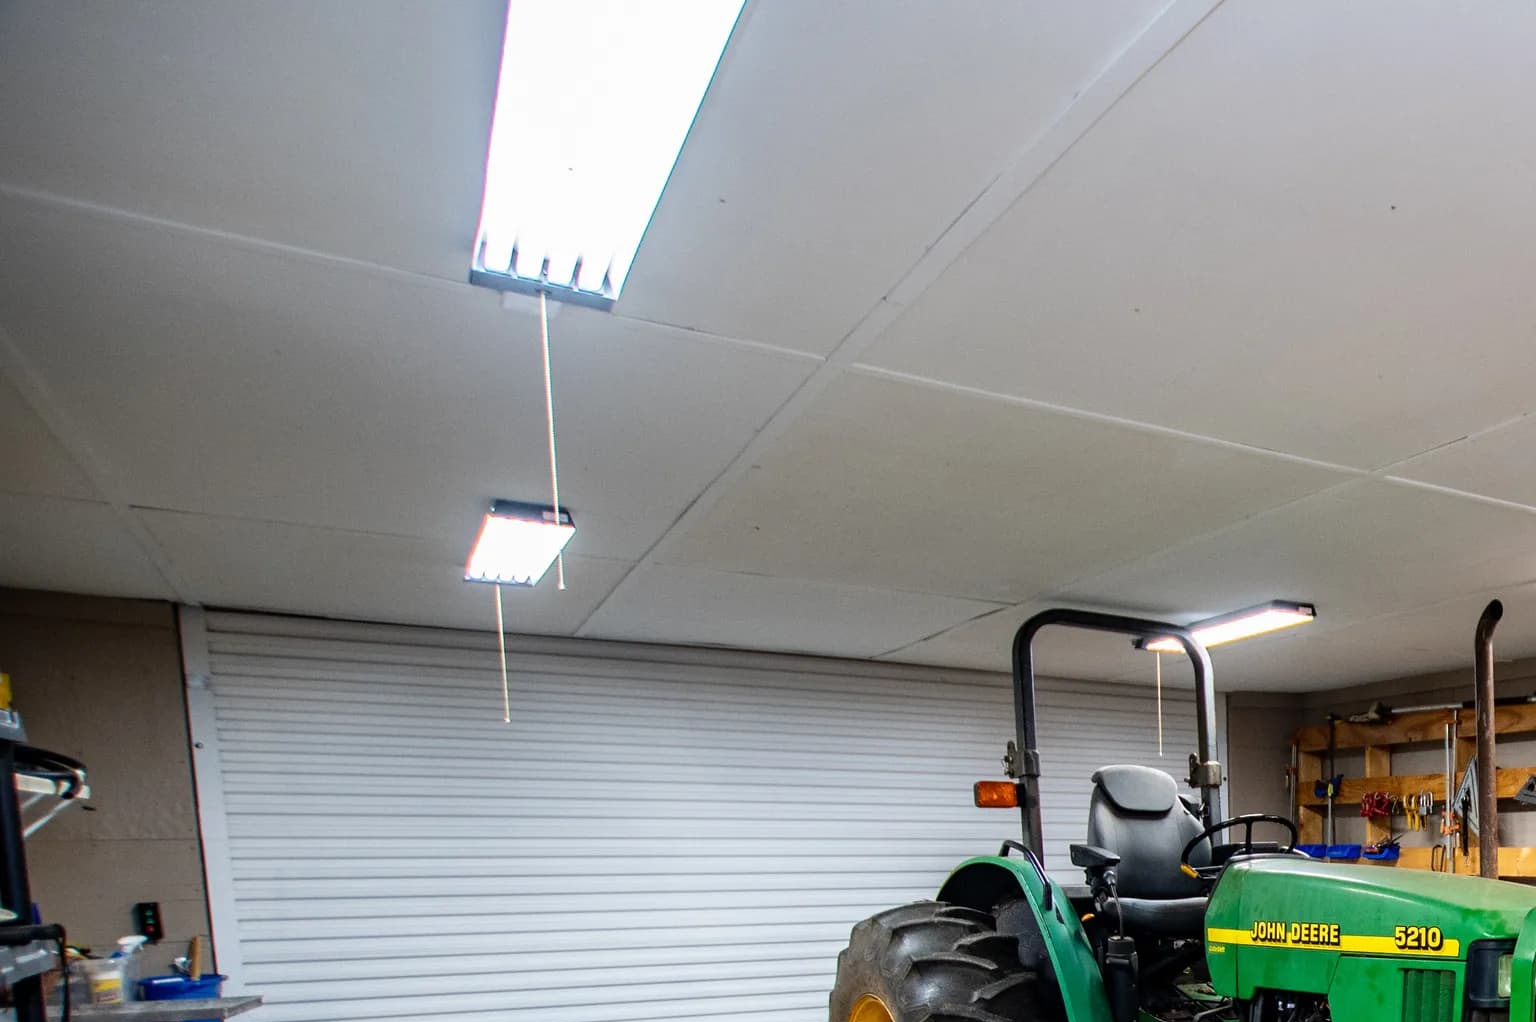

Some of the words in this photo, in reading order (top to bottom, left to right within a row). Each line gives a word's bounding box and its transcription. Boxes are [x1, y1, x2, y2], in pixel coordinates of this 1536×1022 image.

[1250, 921, 1287, 943] JOHN
[1291, 922, 1340, 945] DEERE
[1394, 925, 1443, 951] 5210
